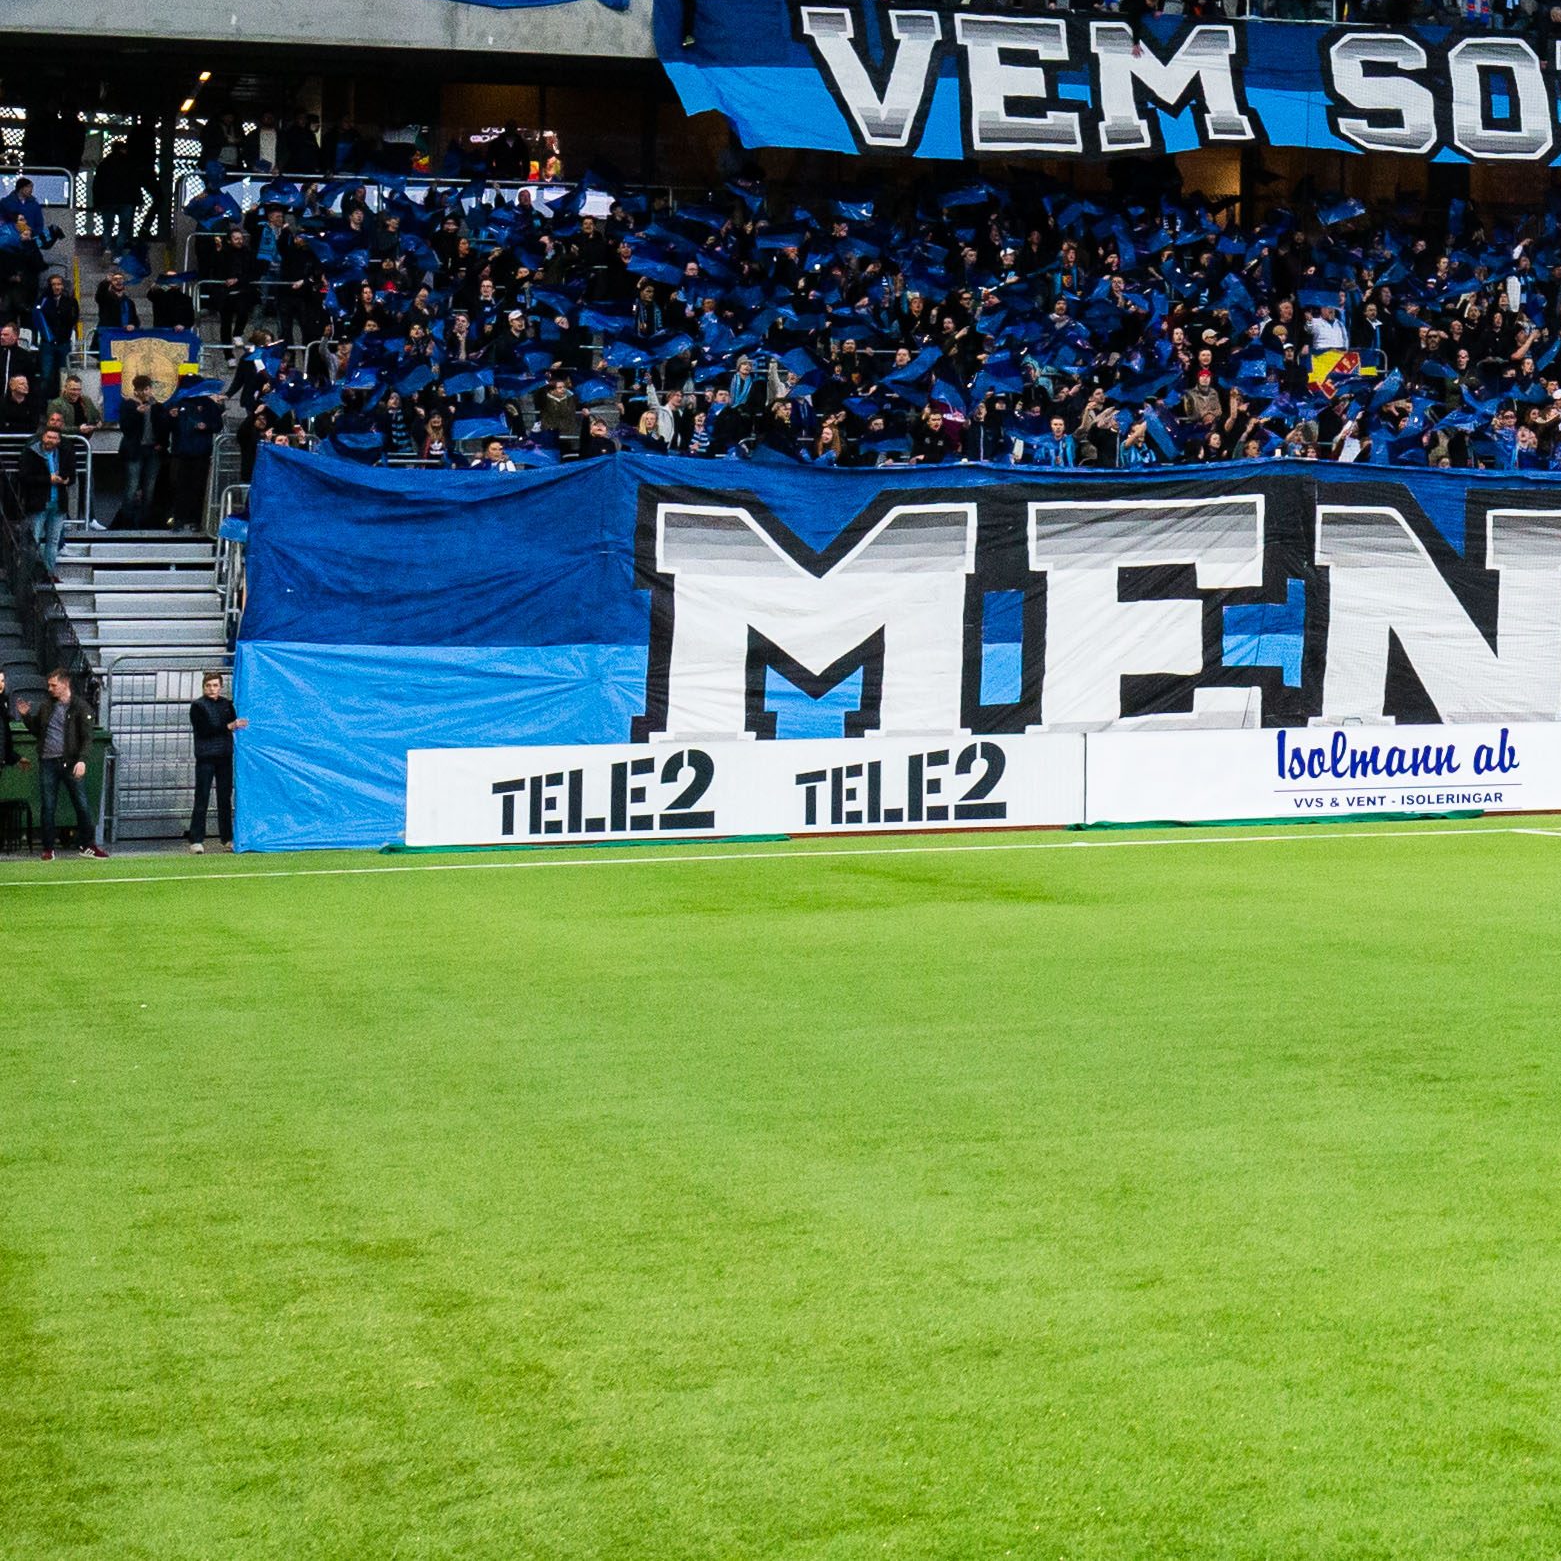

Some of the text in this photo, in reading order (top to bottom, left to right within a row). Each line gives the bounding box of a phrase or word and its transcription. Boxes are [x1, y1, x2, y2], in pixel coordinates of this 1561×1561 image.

[802, 5, 1261, 153] VEM
[491, 748, 716, 836] TELE2
[795, 741, 1007, 827] TELE2
[1276, 727, 1521, 780] Isolmann ab
[1294, 796, 1325, 809] VVS
[1329, 796, 1340, 808] &
[1346, 794, 1388, 808] VENT
[1400, 791, 1504, 806] ISOLERINGAR
